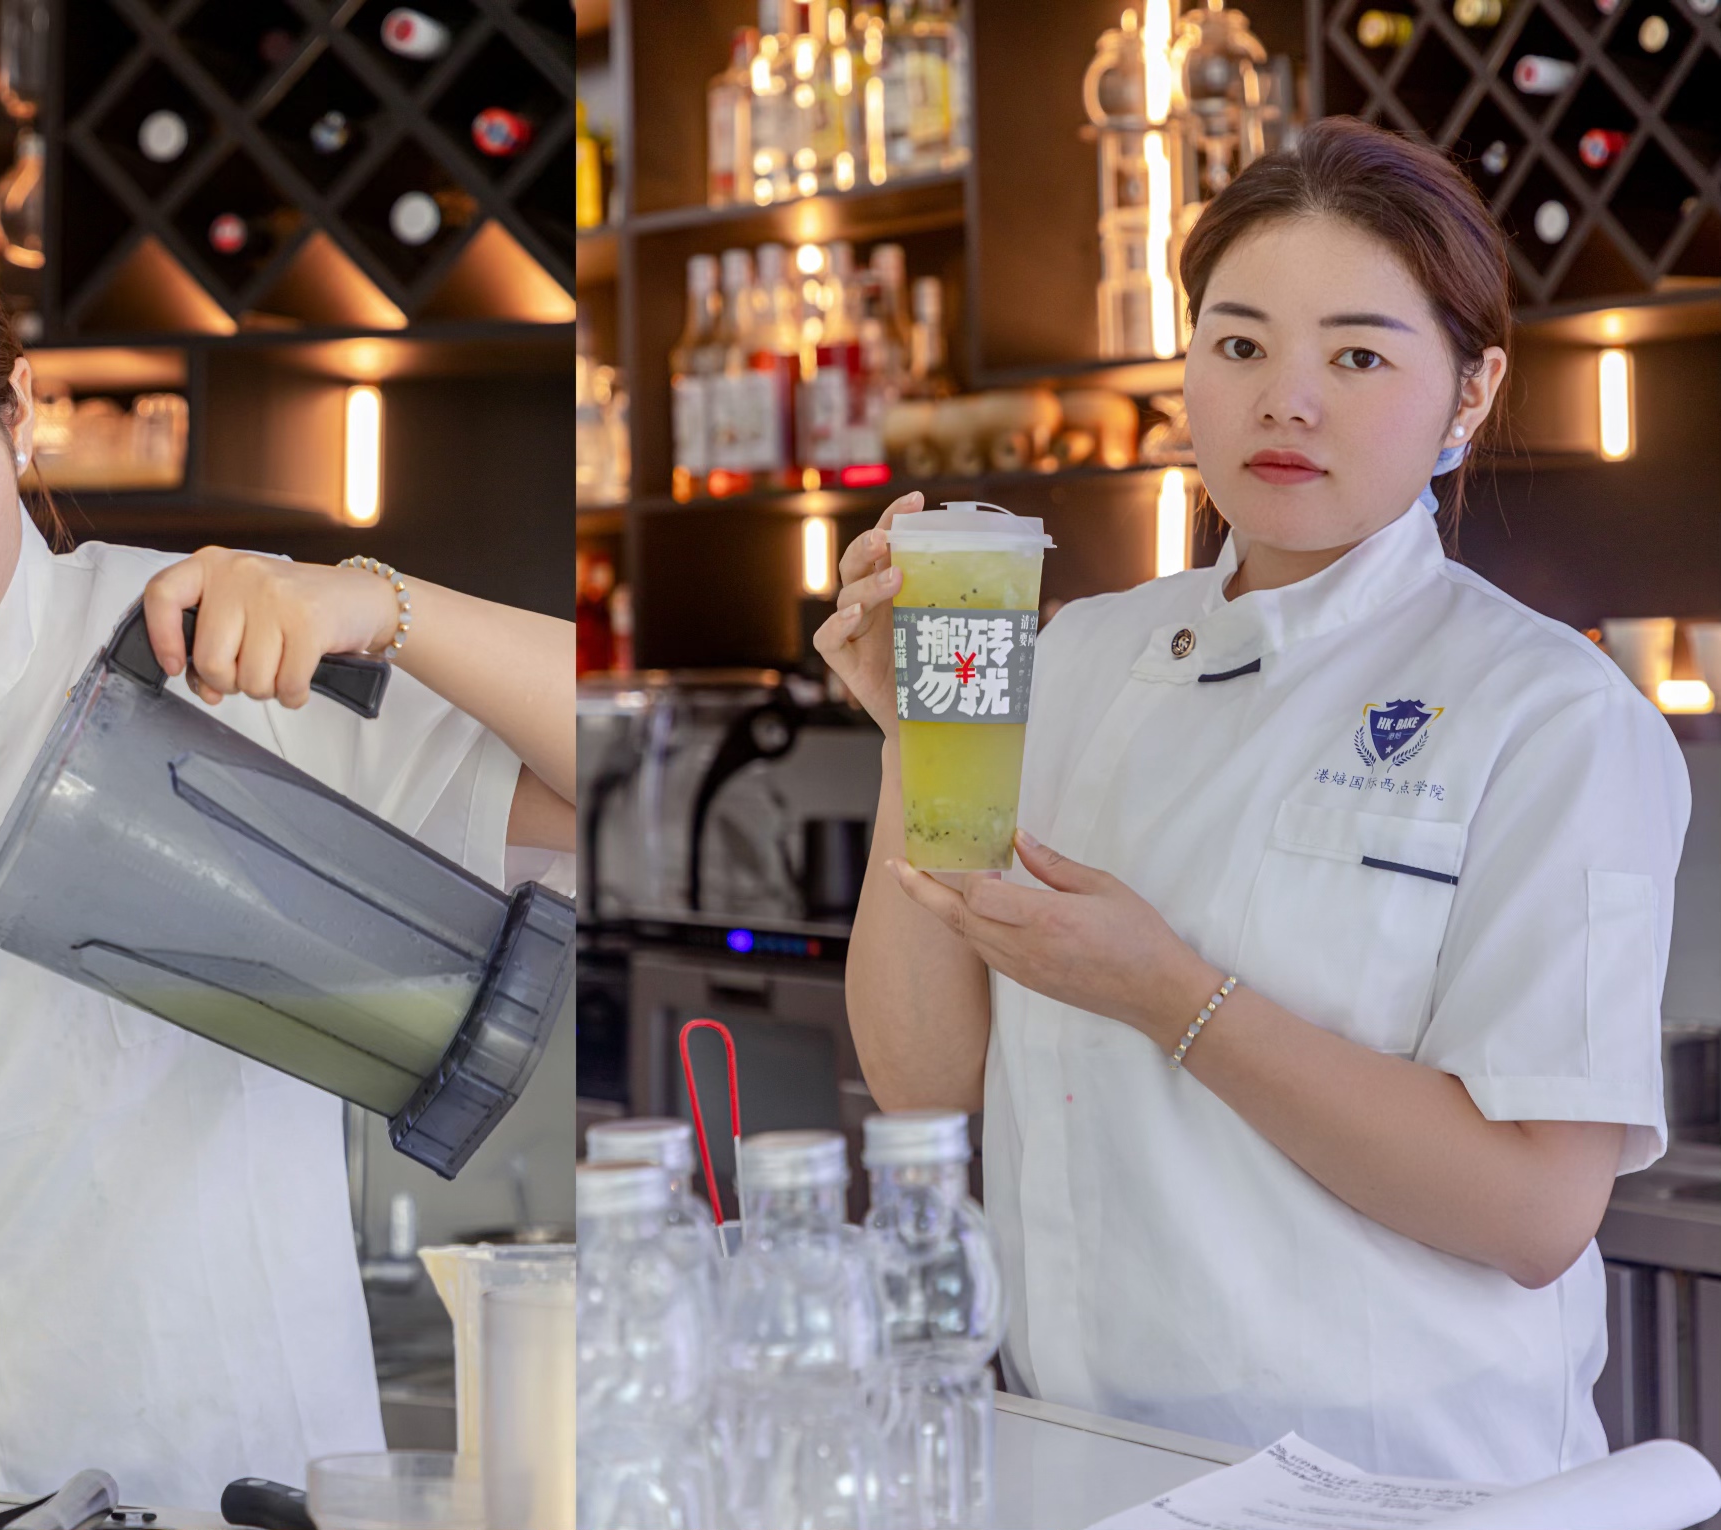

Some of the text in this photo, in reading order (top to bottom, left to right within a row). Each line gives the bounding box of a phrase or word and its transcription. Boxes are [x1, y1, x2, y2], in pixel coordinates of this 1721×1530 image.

[1314, 768, 1446, 801] 港焙国际西点学院
